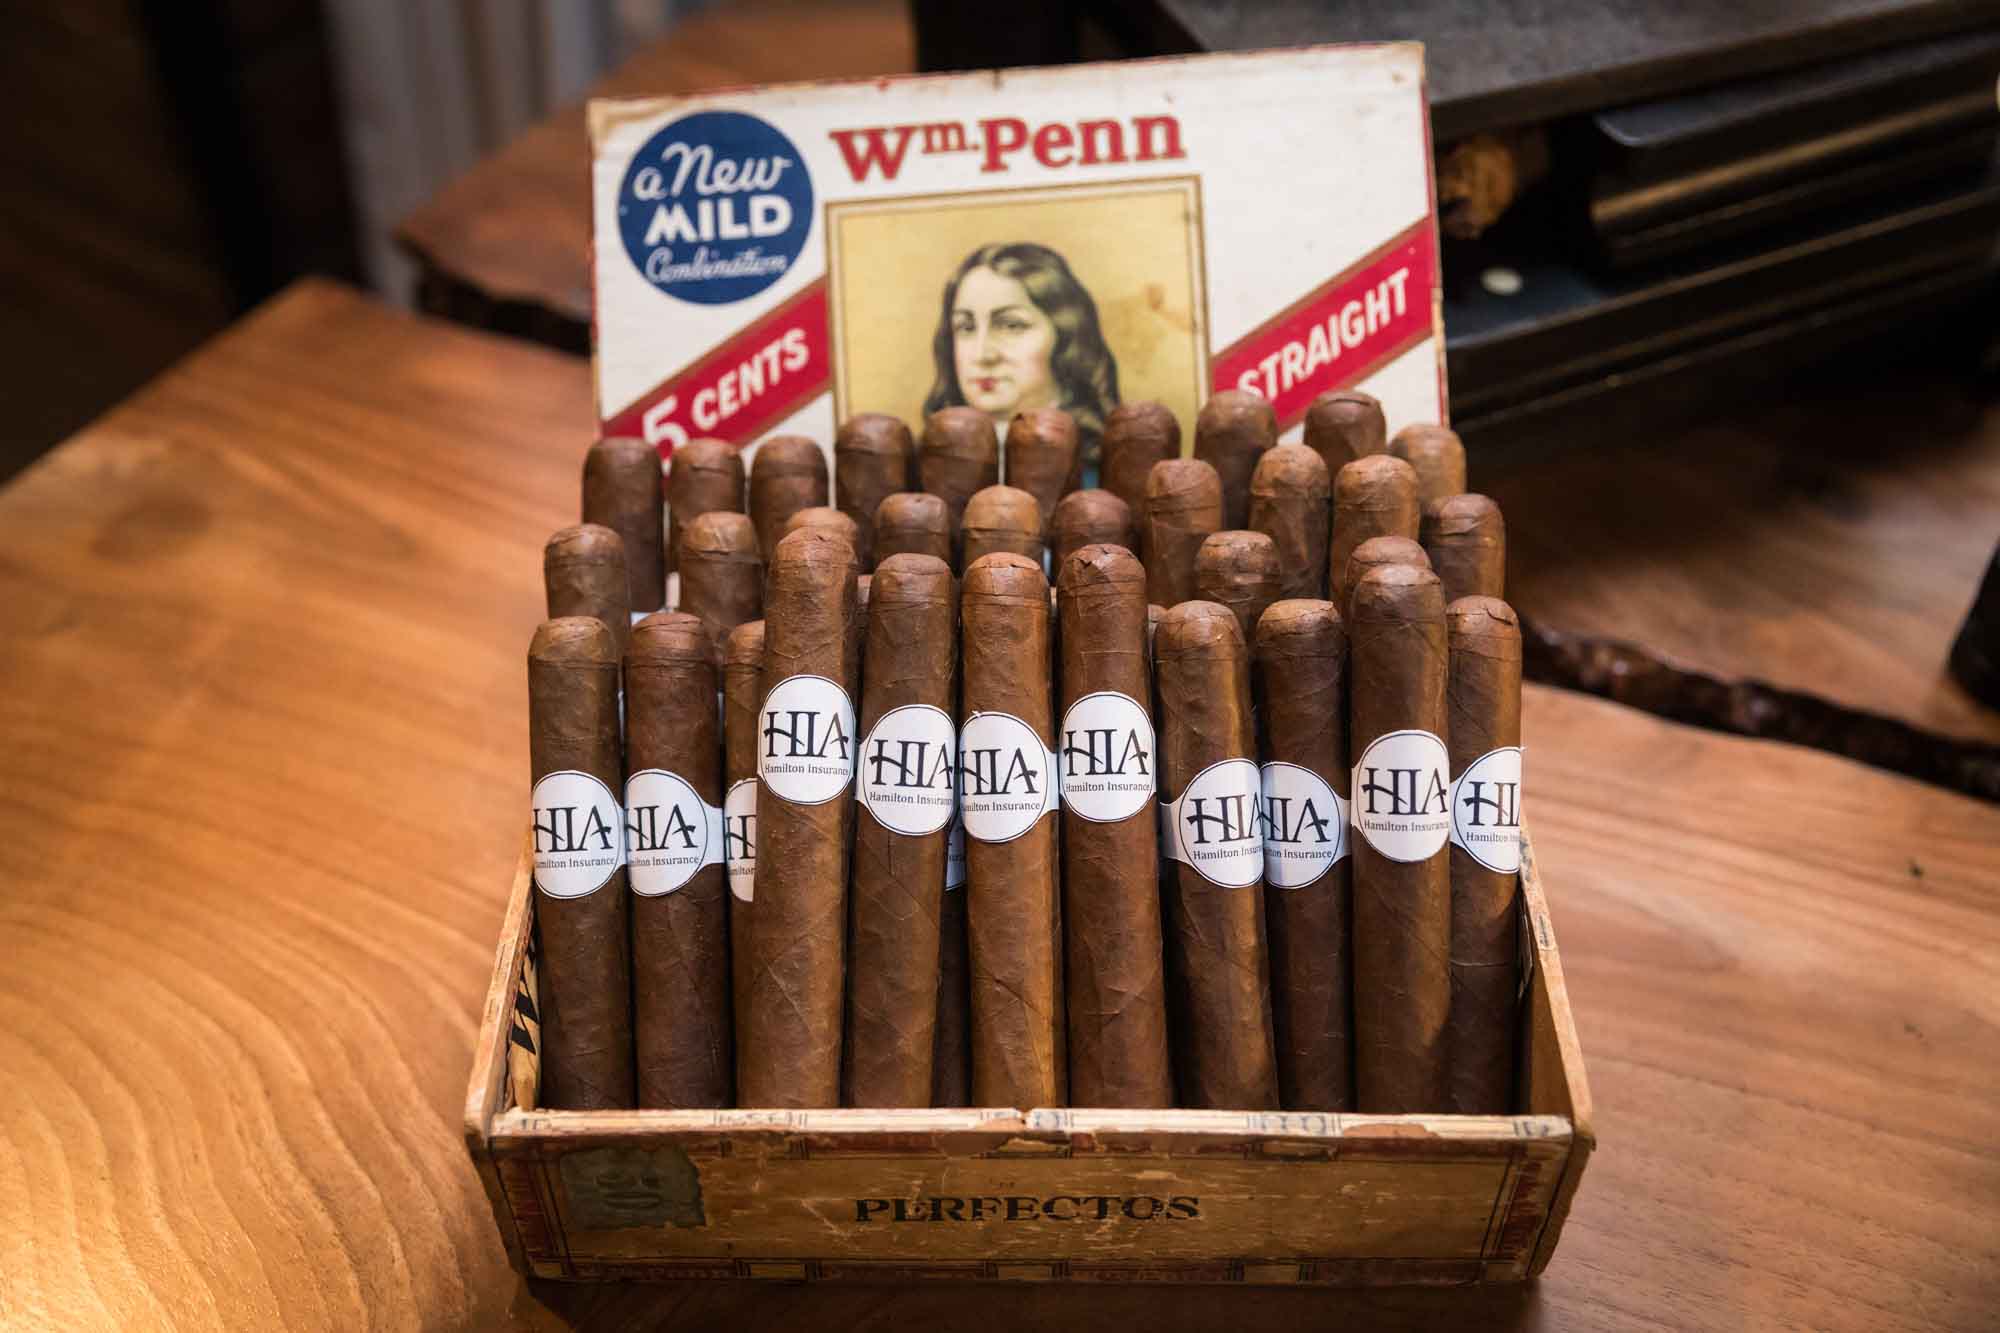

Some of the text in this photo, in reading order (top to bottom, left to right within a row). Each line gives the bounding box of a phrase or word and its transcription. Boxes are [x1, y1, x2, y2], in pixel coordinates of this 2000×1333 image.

[978, 113, 1187, 173] Penn
[633, 142, 793, 200] a New
[644, 195, 793, 246] MILD
[645, 247, 788, 283] Combination
[1237, 267, 1409, 400] STRAIGHT
[691, 328, 809, 431] CENTS
[764, 711, 849, 760] HIA
[1063, 728, 1149, 776] HIA
[765, 763, 805, 774] Hamilton
[869, 739, 953, 789] HIA
[870, 791, 914, 804] Hamilton
[1065, 781, 1150, 792] Hamilton Insurance
[1361, 767, 1448, 815] HIA
[1463, 781, 1520, 827] HI
[992, 801, 1040, 811] Insurance
[1364, 819, 1408, 831] Hamilton
[569, 857, 615, 868] Insurance
[652, 856, 700, 866] Insurance
[1193, 848, 1239, 860] Hamilton
[1283, 848, 1333, 858] Insurance
[855, 1195, 1200, 1222] PERFECTOS
